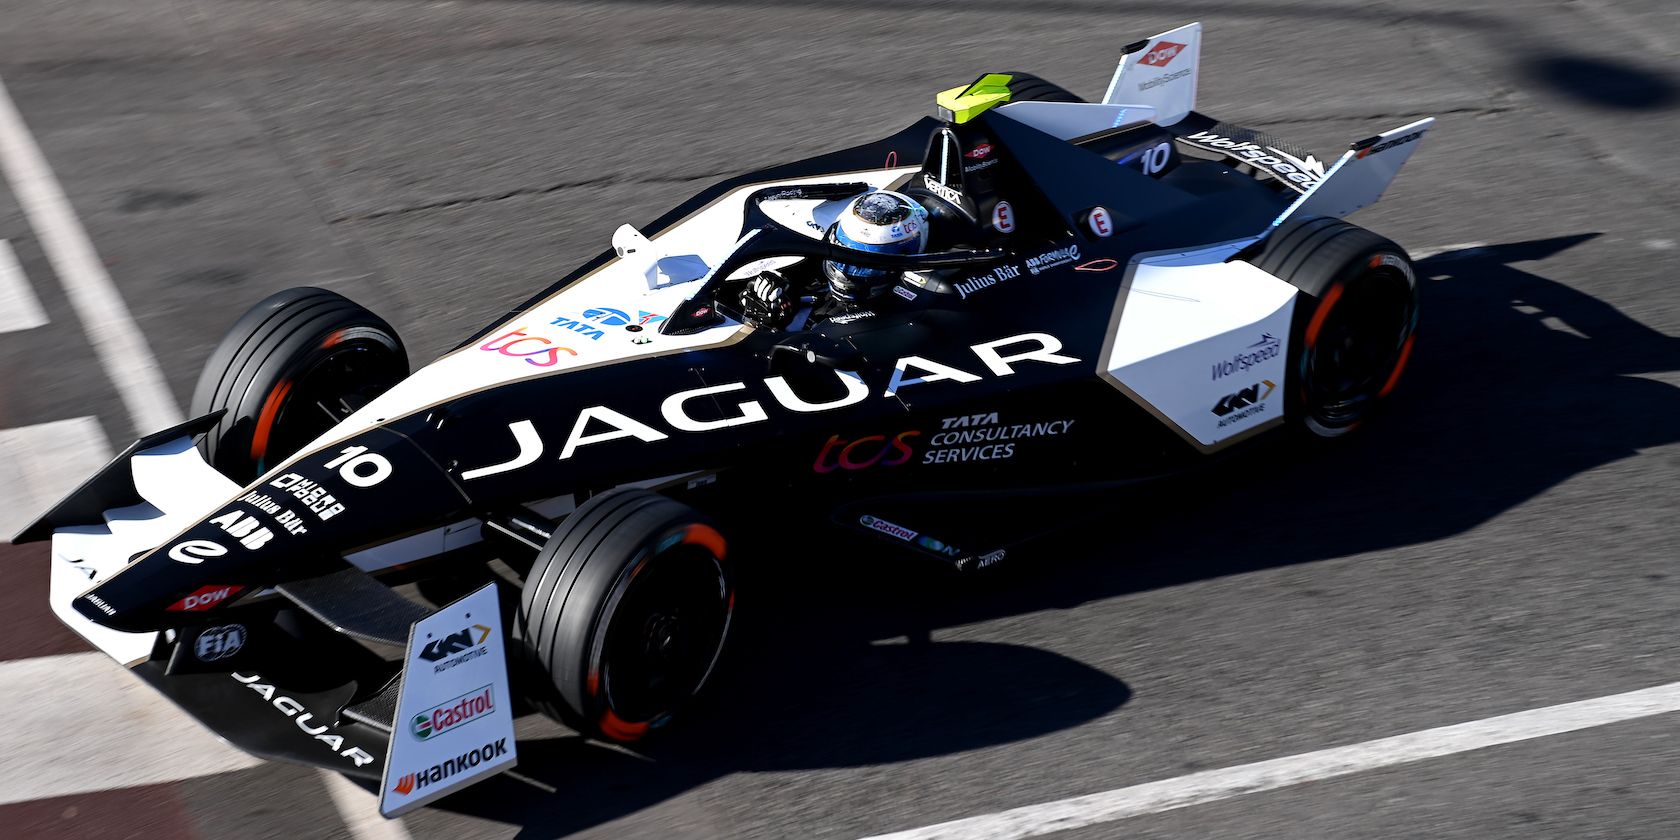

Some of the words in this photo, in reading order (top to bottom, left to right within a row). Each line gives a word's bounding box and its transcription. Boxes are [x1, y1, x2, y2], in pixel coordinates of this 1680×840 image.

[1140, 142, 1171, 176] 10
[998, 207, 1010, 229] E
[1094, 213, 1108, 234] E
[953, 274, 997, 299] Julius
[993, 264, 1021, 282] Bär
[550, 316, 605, 341] TATA
[480, 326, 578, 367] tcs
[1212, 342, 1281, 381] Wolfspeed
[462, 332, 1081, 481] JAGUAR
[941, 412, 999, 429] TATA
[1217, 403, 1265, 428] AUTOMOTIVE
[930, 419, 1075, 446] CONSULTANCY
[323, 445, 393, 487] 10
[813, 430, 921, 473] tcs
[922, 443, 1015, 464] SERVICES
[237, 490, 282, 515] Julius
[209, 510, 274, 550] ABB
[873, 520, 915, 541] Castrol
[197, 629, 241, 657] FIA
[434, 646, 488, 675] AUTOMOTIVE
[231, 671, 375, 767] JAGUAR
[431, 688, 493, 731] Castrol
